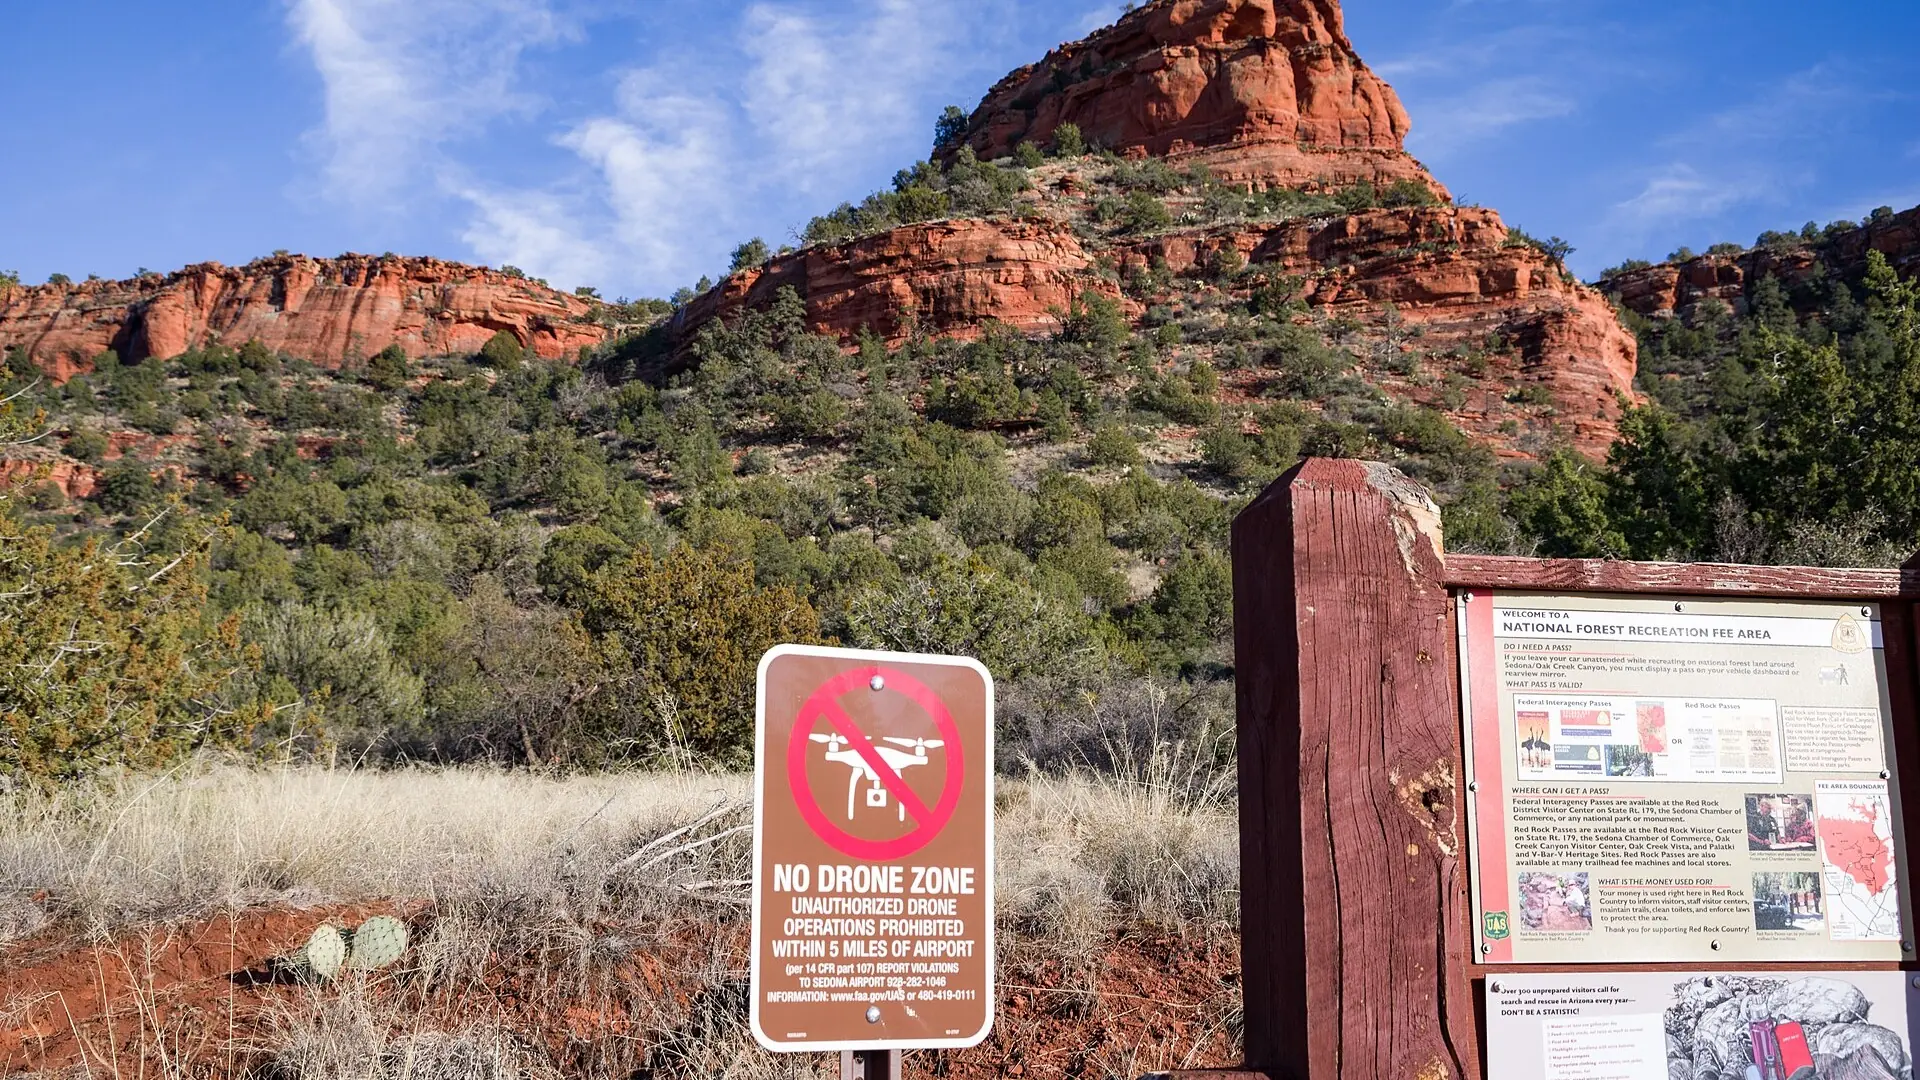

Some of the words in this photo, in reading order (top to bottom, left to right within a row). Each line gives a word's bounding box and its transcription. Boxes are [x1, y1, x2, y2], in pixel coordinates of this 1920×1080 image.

[1503, 623, 1573, 633] NATIONAL
[1576, 625, 1624, 635] FOREST
[1628, 626, 1708, 637] RECREATION
[1713, 629, 1734, 638] FEE
[1737, 629, 1771, 639] AREA
[774, 864, 810, 892] NO
[818, 864, 904, 893] DRONE
[910, 867, 975, 894] ZONE
[792, 898, 904, 915] UNAUTHORIZED
[908, 899, 957, 915] DRONE
[784, 919, 876, 936] OPERATIONS
[879, 920, 964, 936] PROHIBITED
[772, 940, 825, 958] WITHIN
[829, 940, 839, 958] 5
[843, 940, 888, 958] MILES
[891, 940, 911, 957] OF
[913, 940, 975, 957] AIRPORT
[786, 964, 803, 977] (per
[806, 964, 816, 974] 14
[818, 963, 835, 974] CFR
[837, 963, 854, 977] part
[857, 963, 874, 977] 107)
[877, 963, 910, 974] REPORT
[911, 963, 959, 974] VIOLATIONS
[799, 977, 811, 988] TO
[812, 977, 848, 988] SEDONA
[849, 977, 886, 988] AIRPORT
[887, 977, 946, 987] 928-282-1046
[1532, 986, 1570, 995] unprepared
[767, 991, 829, 1002] INFORMATION:
[831, 990, 905, 1004] www.faa.gov/UAS
[918, 990, 975, 1000] 480-419-0111
